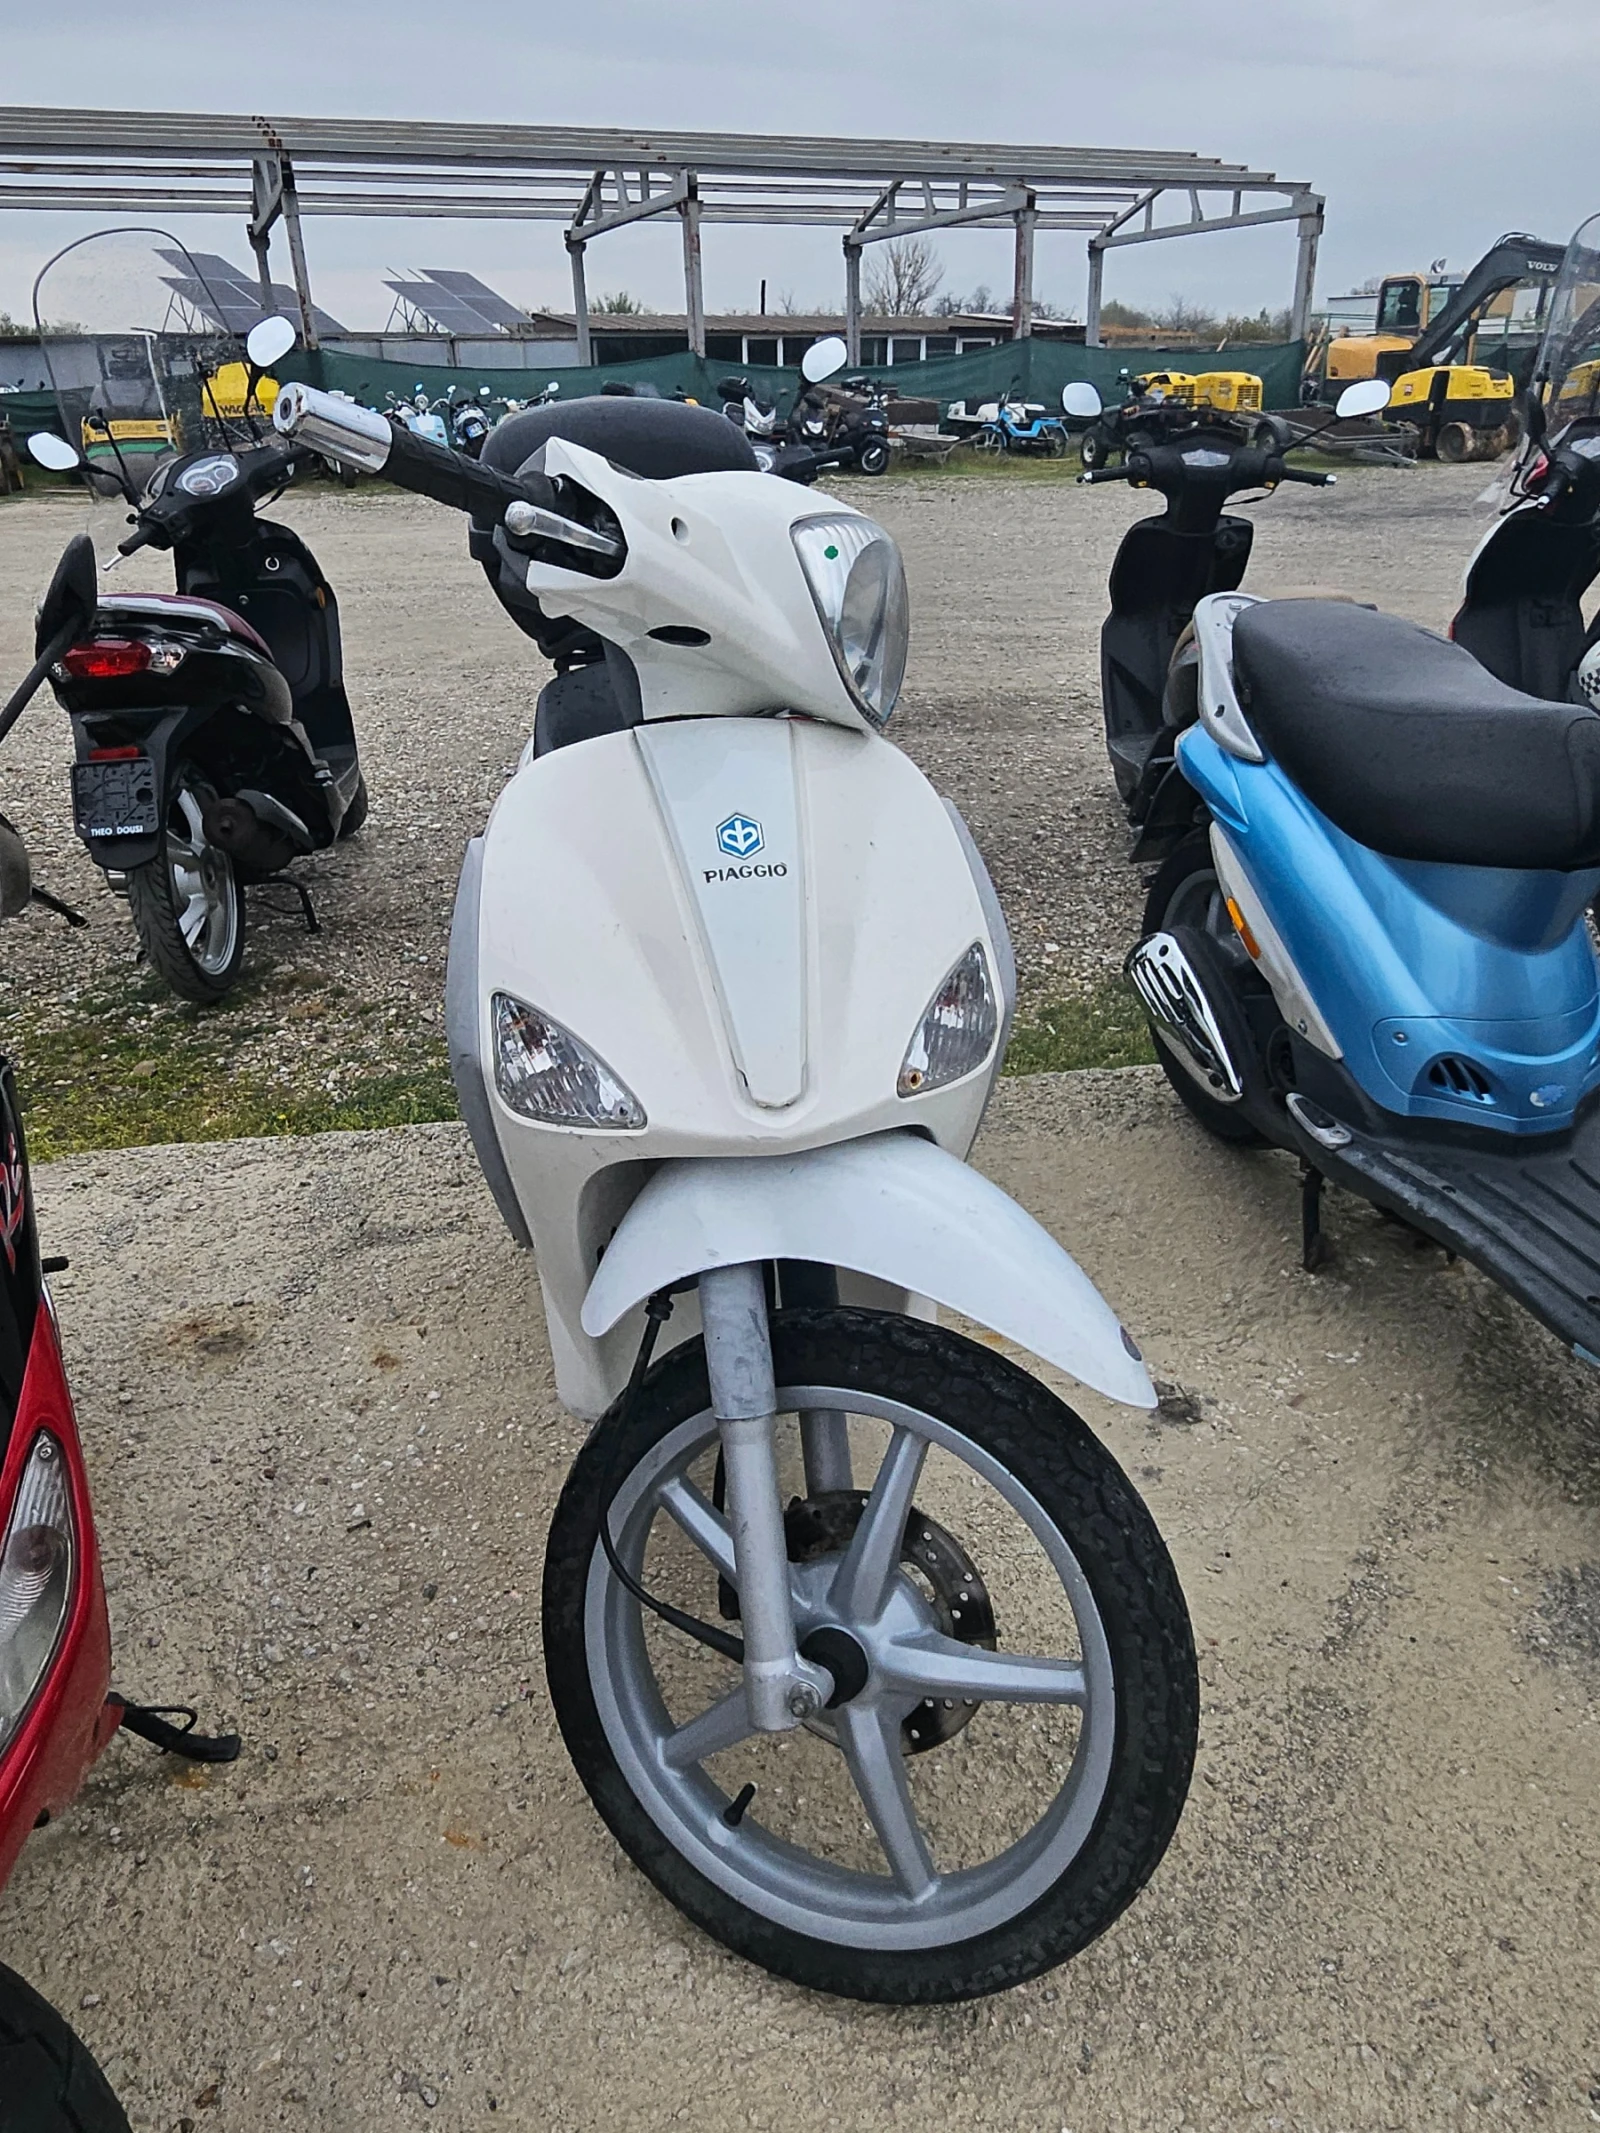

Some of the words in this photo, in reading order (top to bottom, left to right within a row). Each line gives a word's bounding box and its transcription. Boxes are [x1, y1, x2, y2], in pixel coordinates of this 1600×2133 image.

[90, 827, 113, 837] THEO
[116, 824, 144, 835] DOUSI
[703, 863, 788, 883] PIAGGIO
